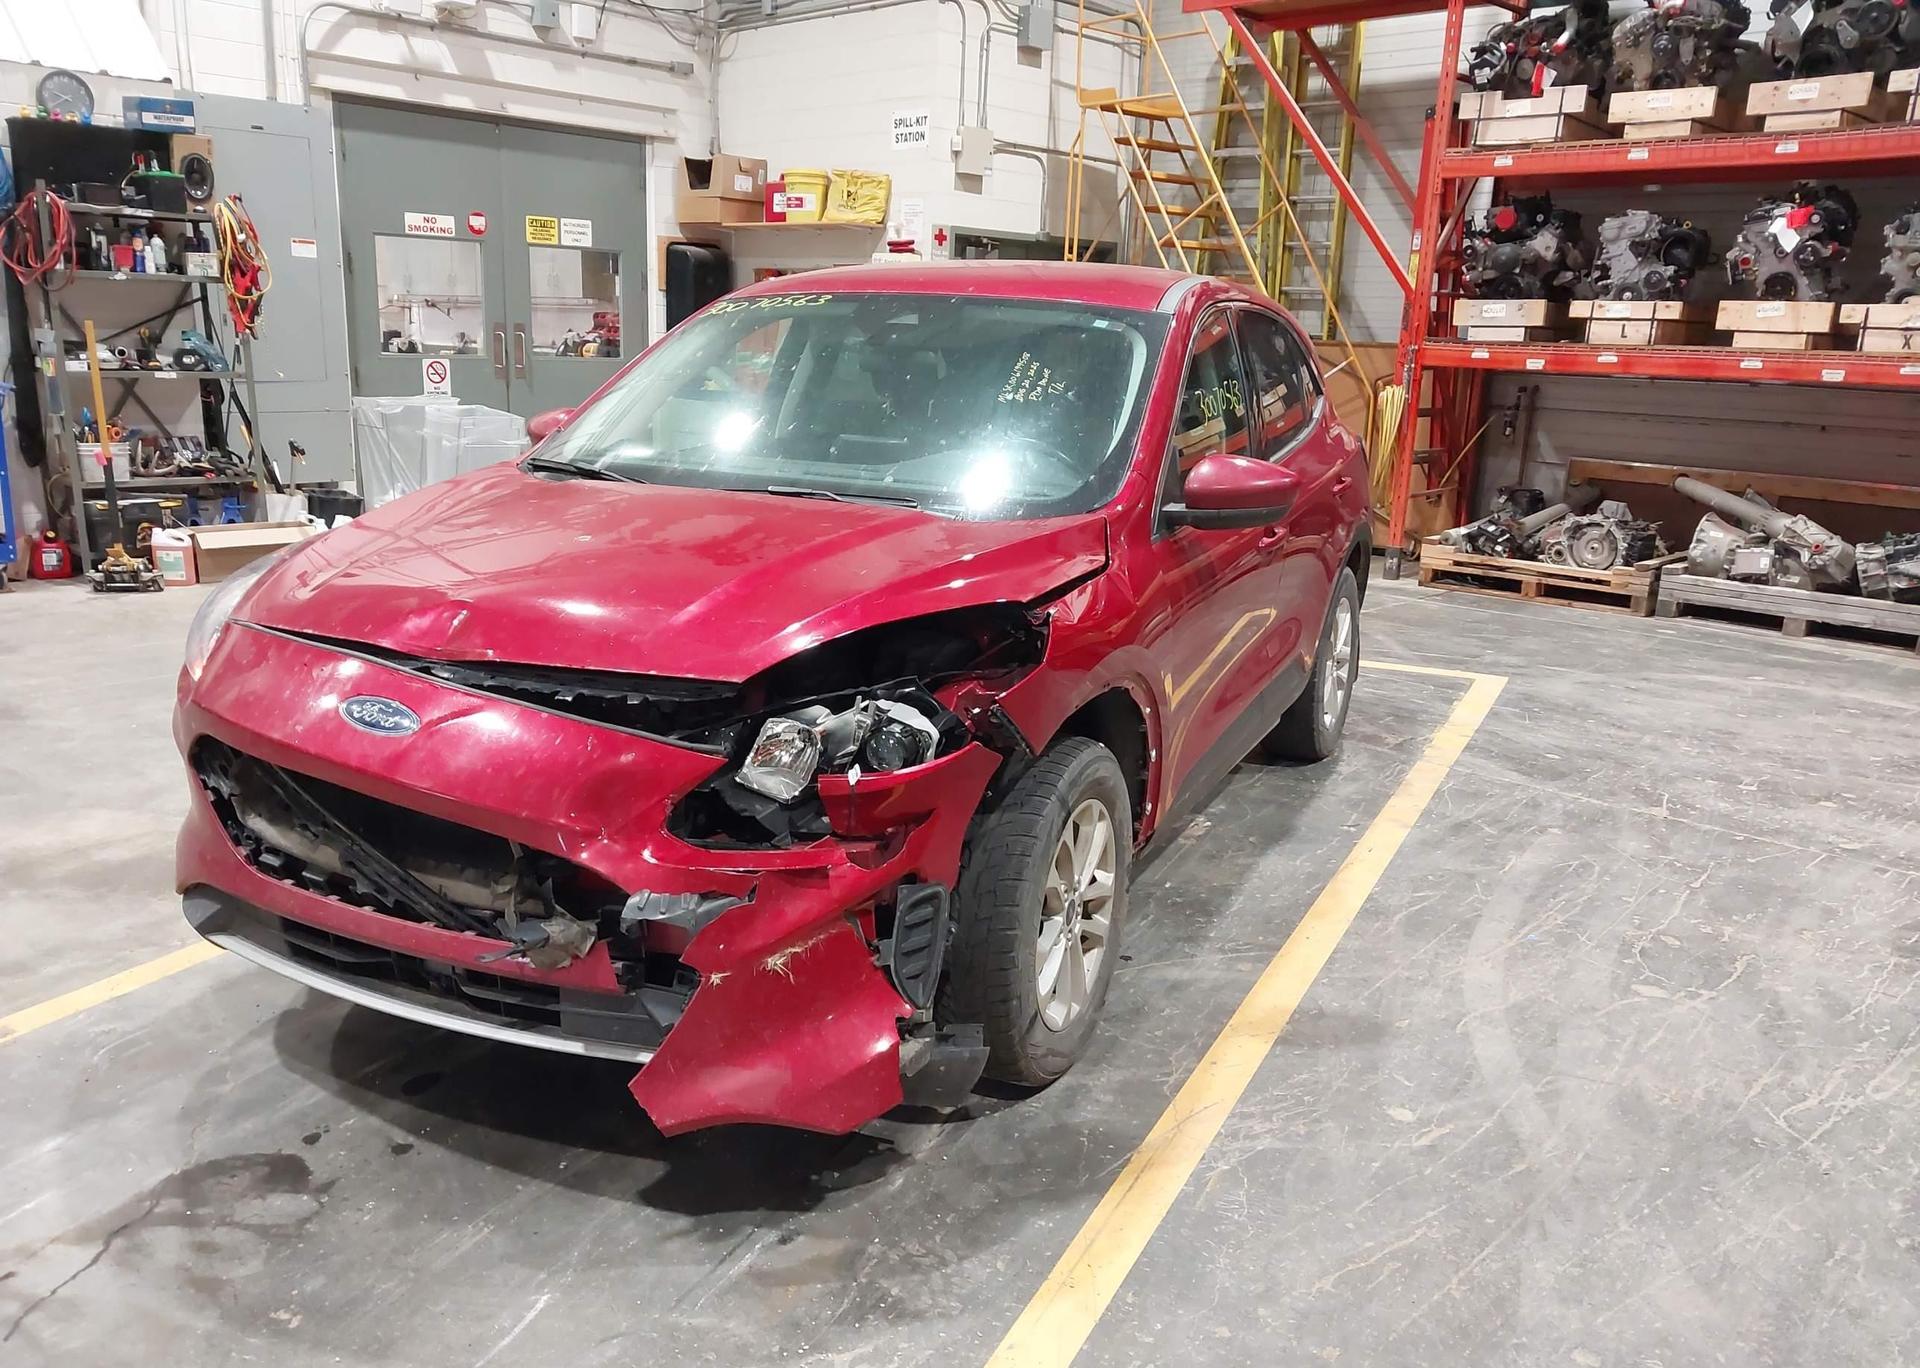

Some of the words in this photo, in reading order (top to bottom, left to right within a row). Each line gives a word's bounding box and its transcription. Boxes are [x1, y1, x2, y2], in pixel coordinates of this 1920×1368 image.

[893, 115, 928, 129] SPILL-KIT
[895, 130, 926, 144] STATION
[423, 216, 437, 224] NO
[528, 218, 555, 229] CAUTION
[407, 224, 453, 235] SMOKING
[1901, 334, 1913, 350] X
